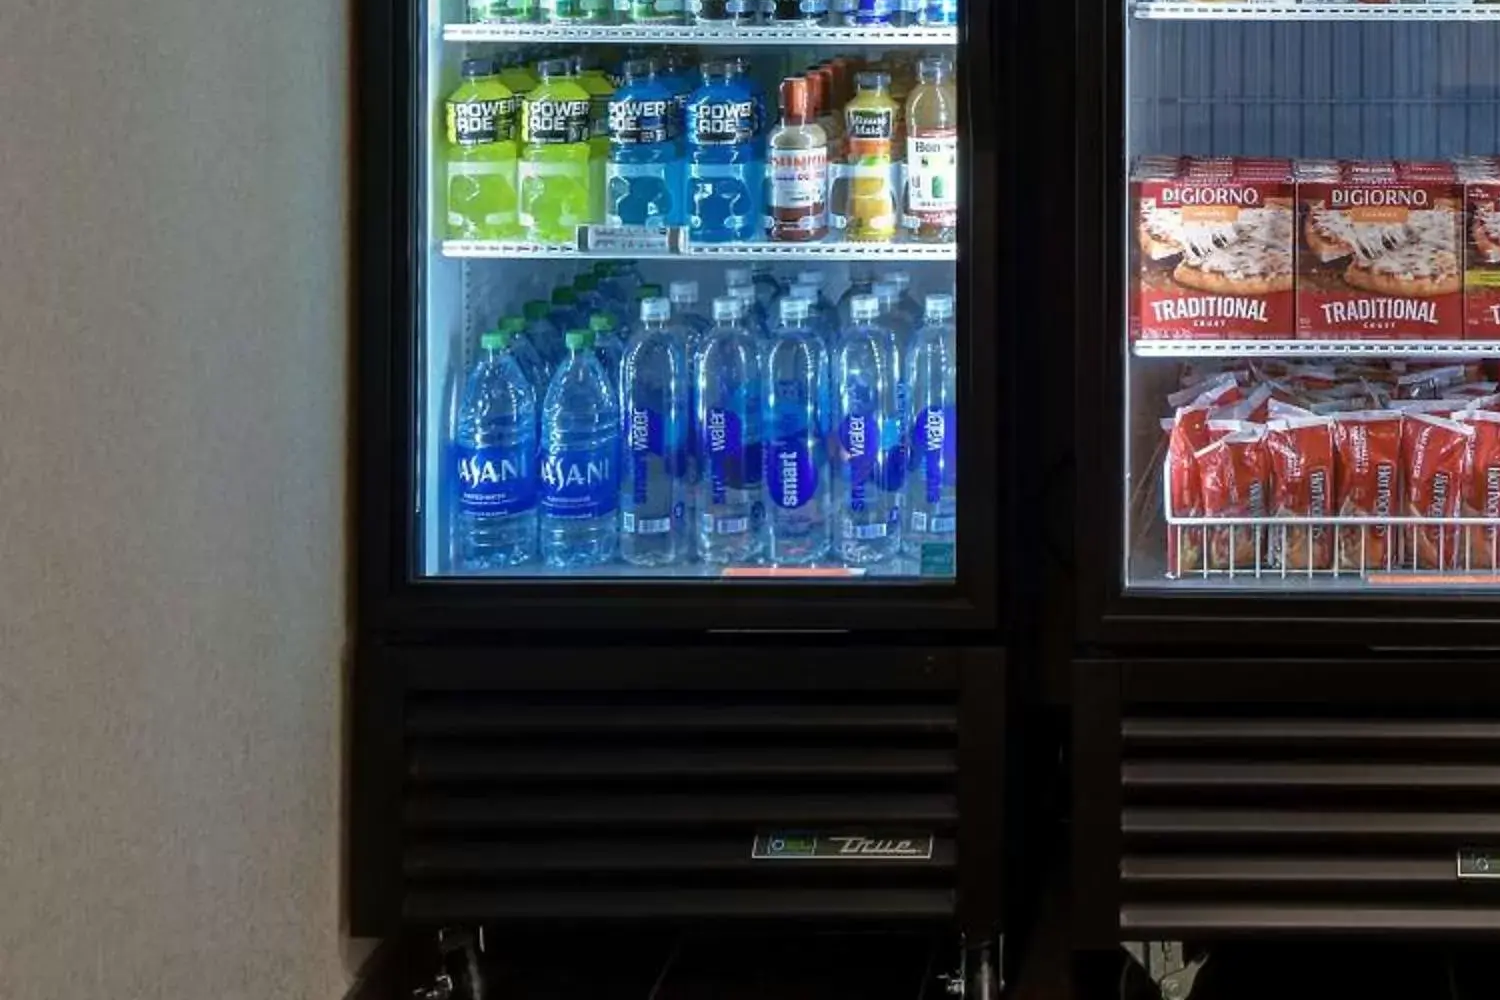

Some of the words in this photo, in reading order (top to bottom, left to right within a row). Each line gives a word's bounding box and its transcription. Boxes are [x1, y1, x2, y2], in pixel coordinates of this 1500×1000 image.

[1151, 296, 1268, 323] TRADITIONAL
[1321, 297, 1439, 325] TRADITIONAL
[633, 408, 649, 451] water
[710, 410, 726, 451] water
[848, 415, 865, 457] water
[925, 409, 944, 451] water
[456, 453, 526, 489] ASANI
[779, 451, 798, 506] smart
